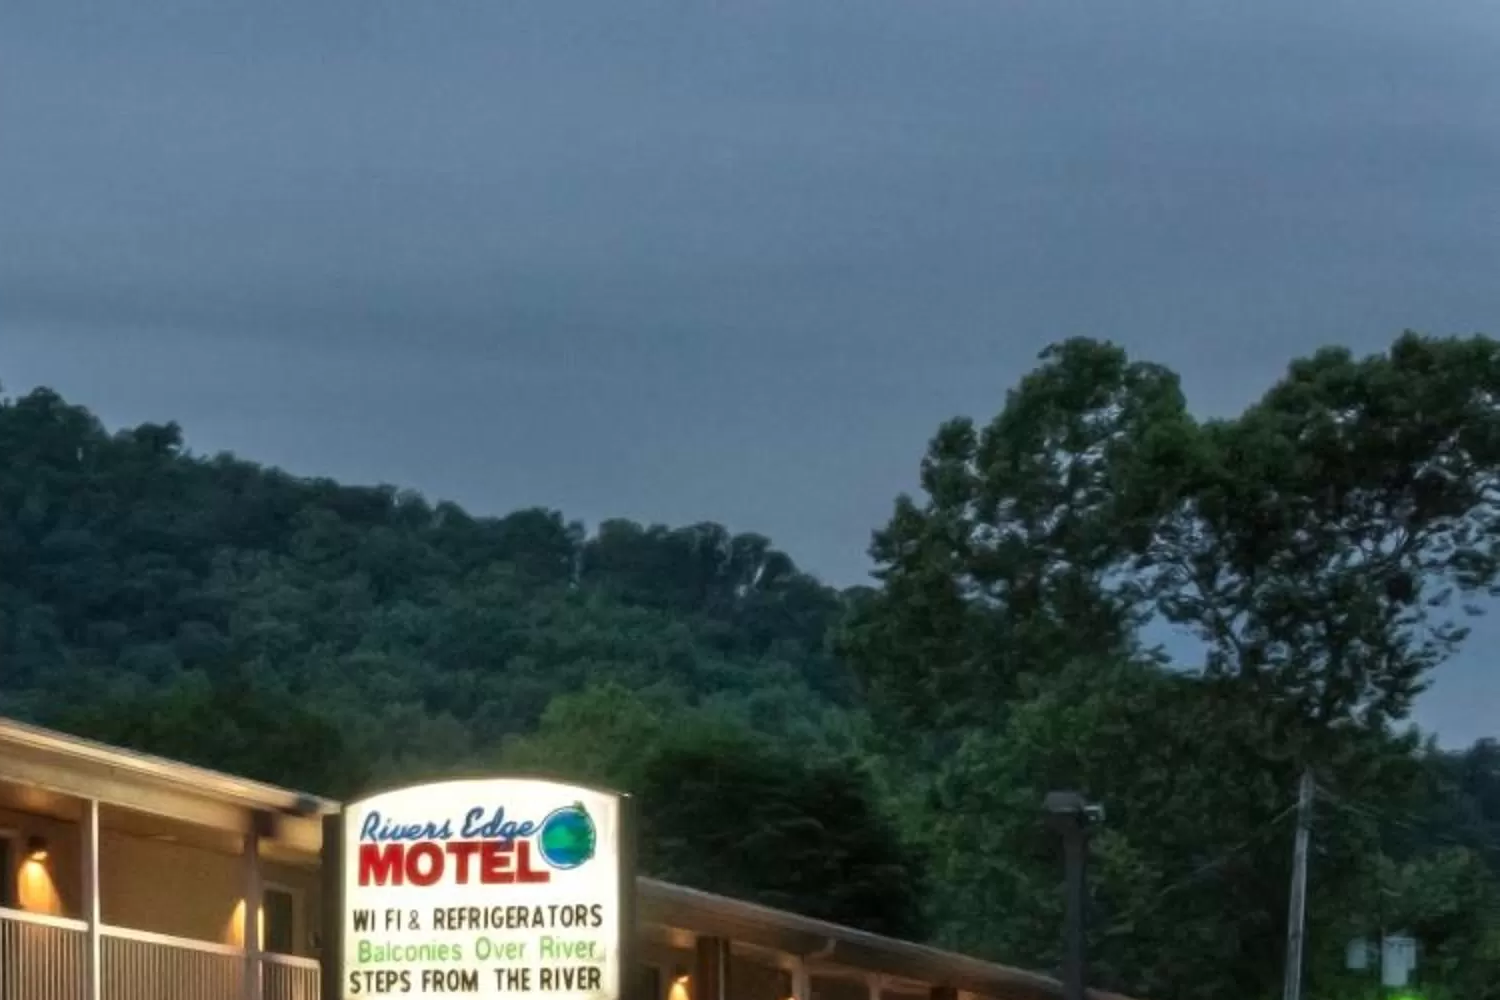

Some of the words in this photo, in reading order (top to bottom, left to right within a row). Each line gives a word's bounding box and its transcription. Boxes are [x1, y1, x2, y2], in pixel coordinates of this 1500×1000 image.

[360, 810, 453, 841] Rivers
[460, 806, 541, 846] Edge
[358, 840, 550, 886] MOTEL
[352, 909, 375, 932] WI
[385, 908, 401, 931] FI
[408, 909, 420, 930] &
[432, 903, 603, 930] REFRIGERATORS
[358, 939, 462, 963] Balconies
[475, 936, 525, 960] Over
[539, 935, 596, 959] River
[350, 969, 411, 994] STEPS
[422, 968, 479, 993] FROM
[494, 967, 531, 992] THE
[539, 966, 601, 991] RIVER
